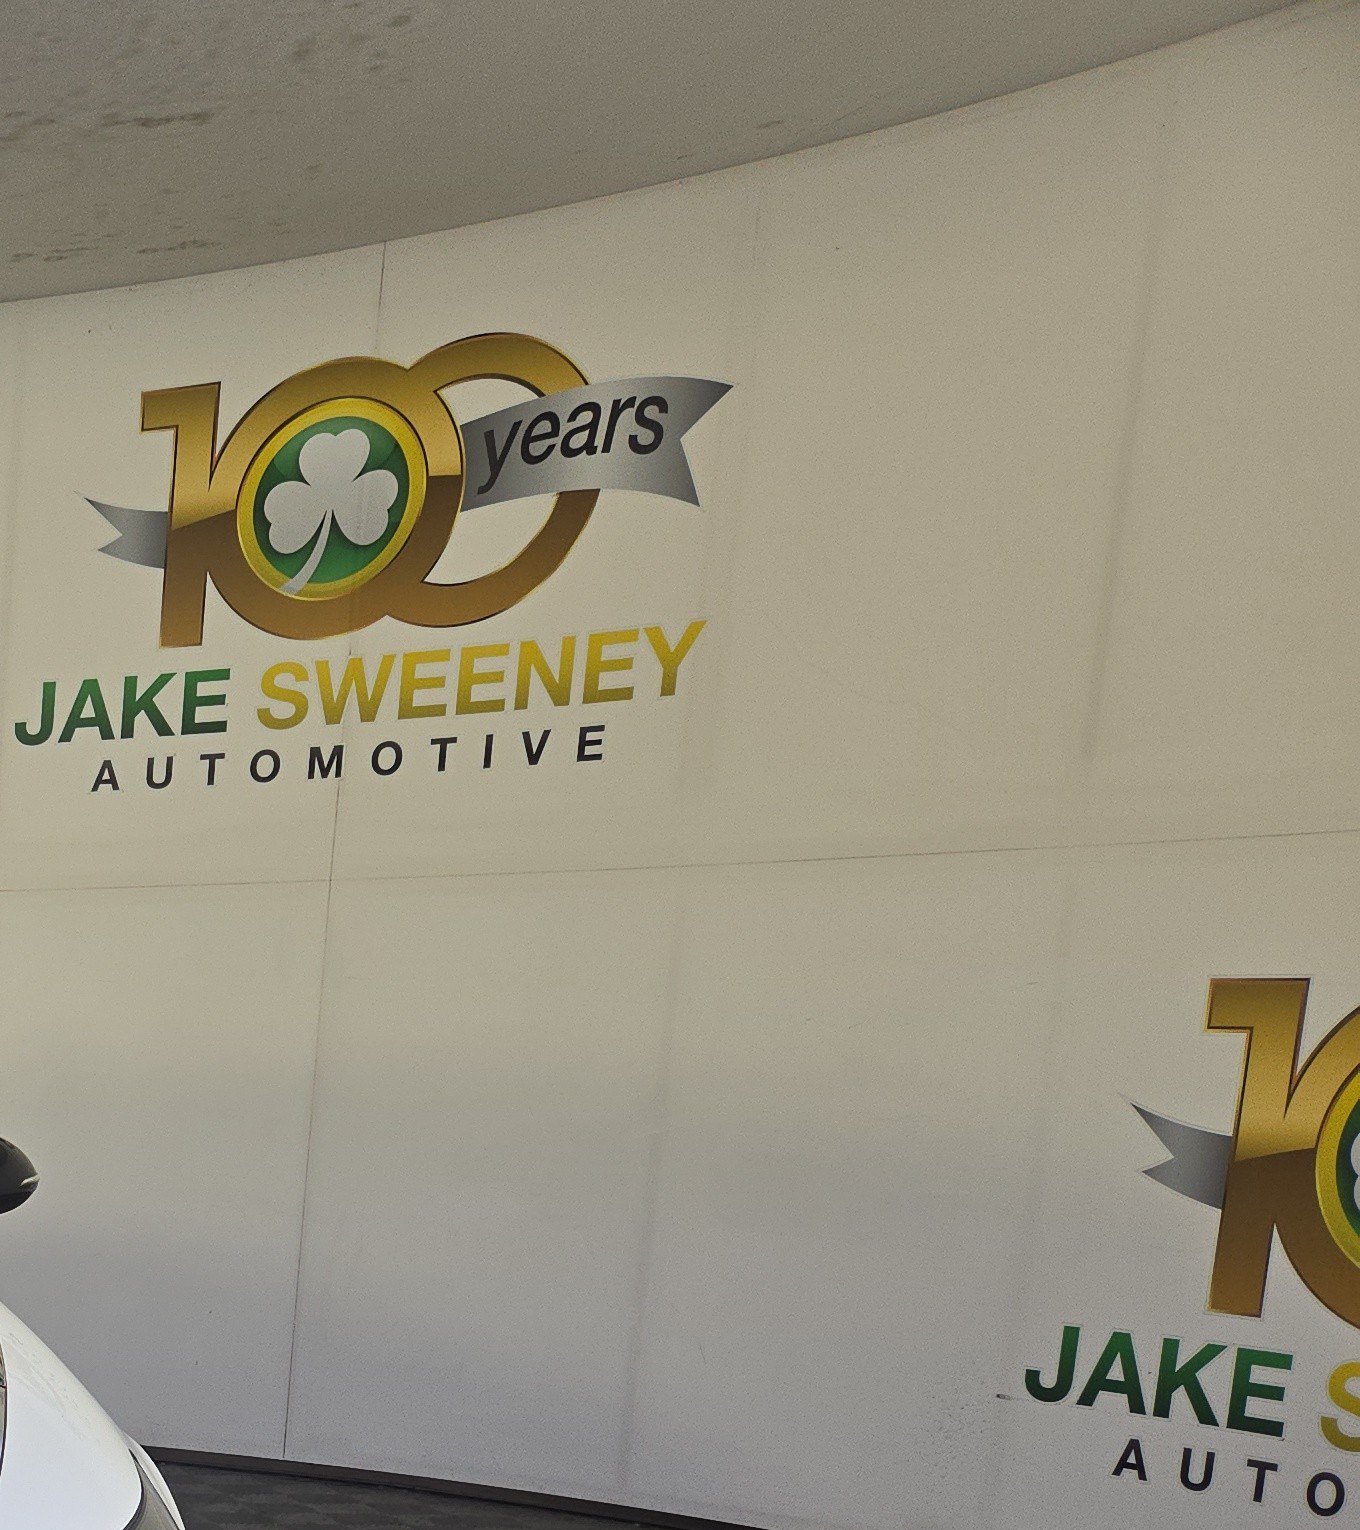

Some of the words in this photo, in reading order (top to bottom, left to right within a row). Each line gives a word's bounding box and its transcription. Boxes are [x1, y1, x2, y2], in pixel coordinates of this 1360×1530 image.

[476, 392, 670, 495] years
[13, 667, 231, 747] JAKE
[255, 619, 708, 730] SWEENEY
[90, 723, 607, 793] AUTOMOTIVE
[1023, 1324, 1295, 1439] JAKE
[1111, 1437, 1347, 1517] AUTO
